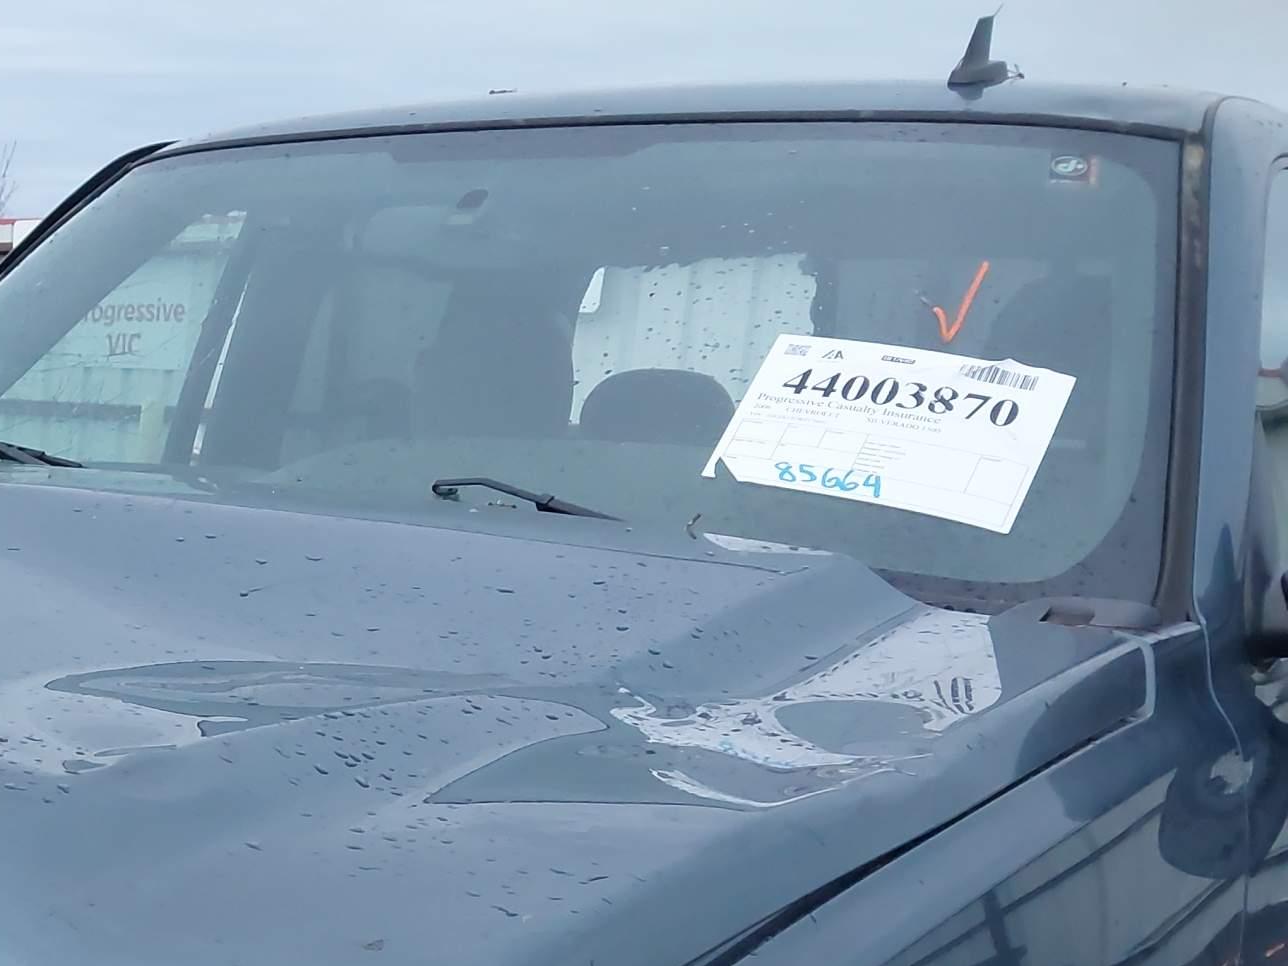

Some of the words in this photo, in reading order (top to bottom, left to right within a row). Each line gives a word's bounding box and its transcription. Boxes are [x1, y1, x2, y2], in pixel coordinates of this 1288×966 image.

[106, 332, 142, 354] VIC
[757, 392, 824, 408] Progressive
[826, 399, 879, 416] Casualty
[882, 407, 942, 425] Insurance
[781, 368, 1019, 427] 44003870
[786, 407, 841, 419] CHEVROLET
[865, 416, 920, 431] SILVERADO
[774, 461, 882, 499] 85664
